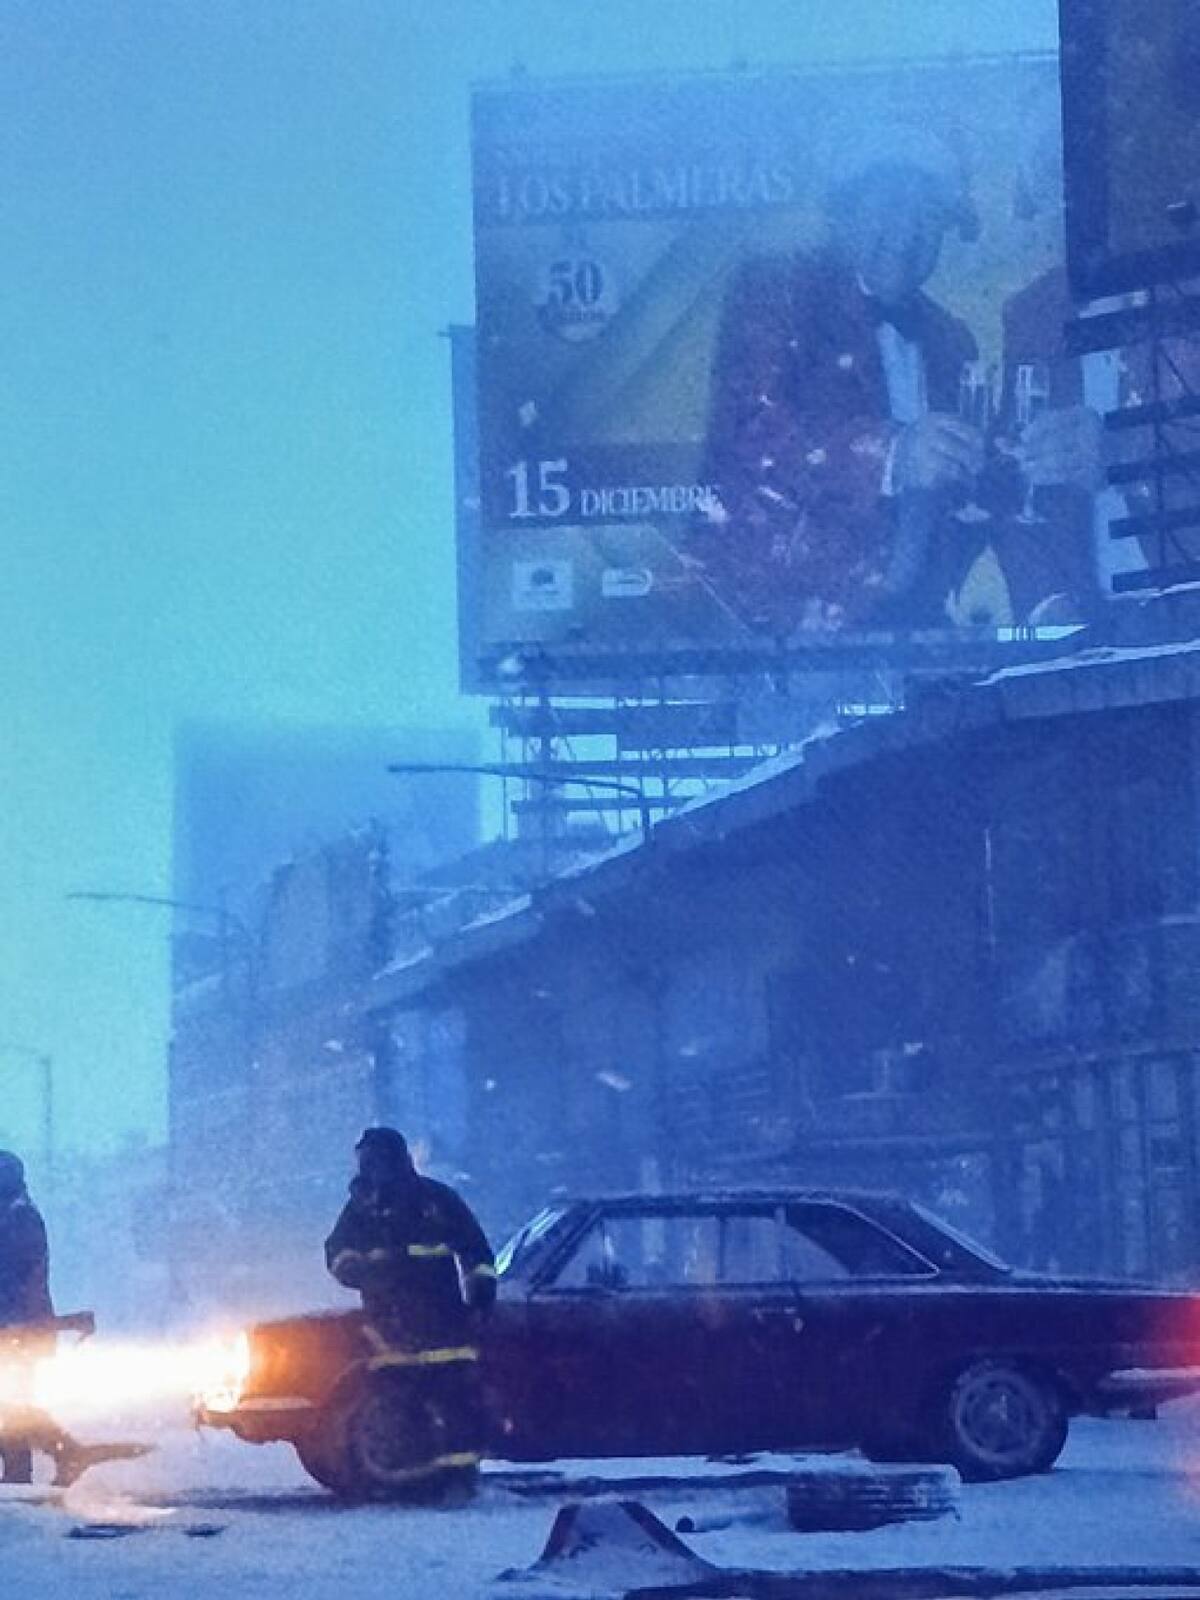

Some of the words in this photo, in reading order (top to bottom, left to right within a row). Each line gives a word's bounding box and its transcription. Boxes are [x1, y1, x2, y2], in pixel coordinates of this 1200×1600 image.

[579, 165, 795, 208] PALMERAS
[548, 261, 603, 304] 50
[506, 458, 571, 518] 15
